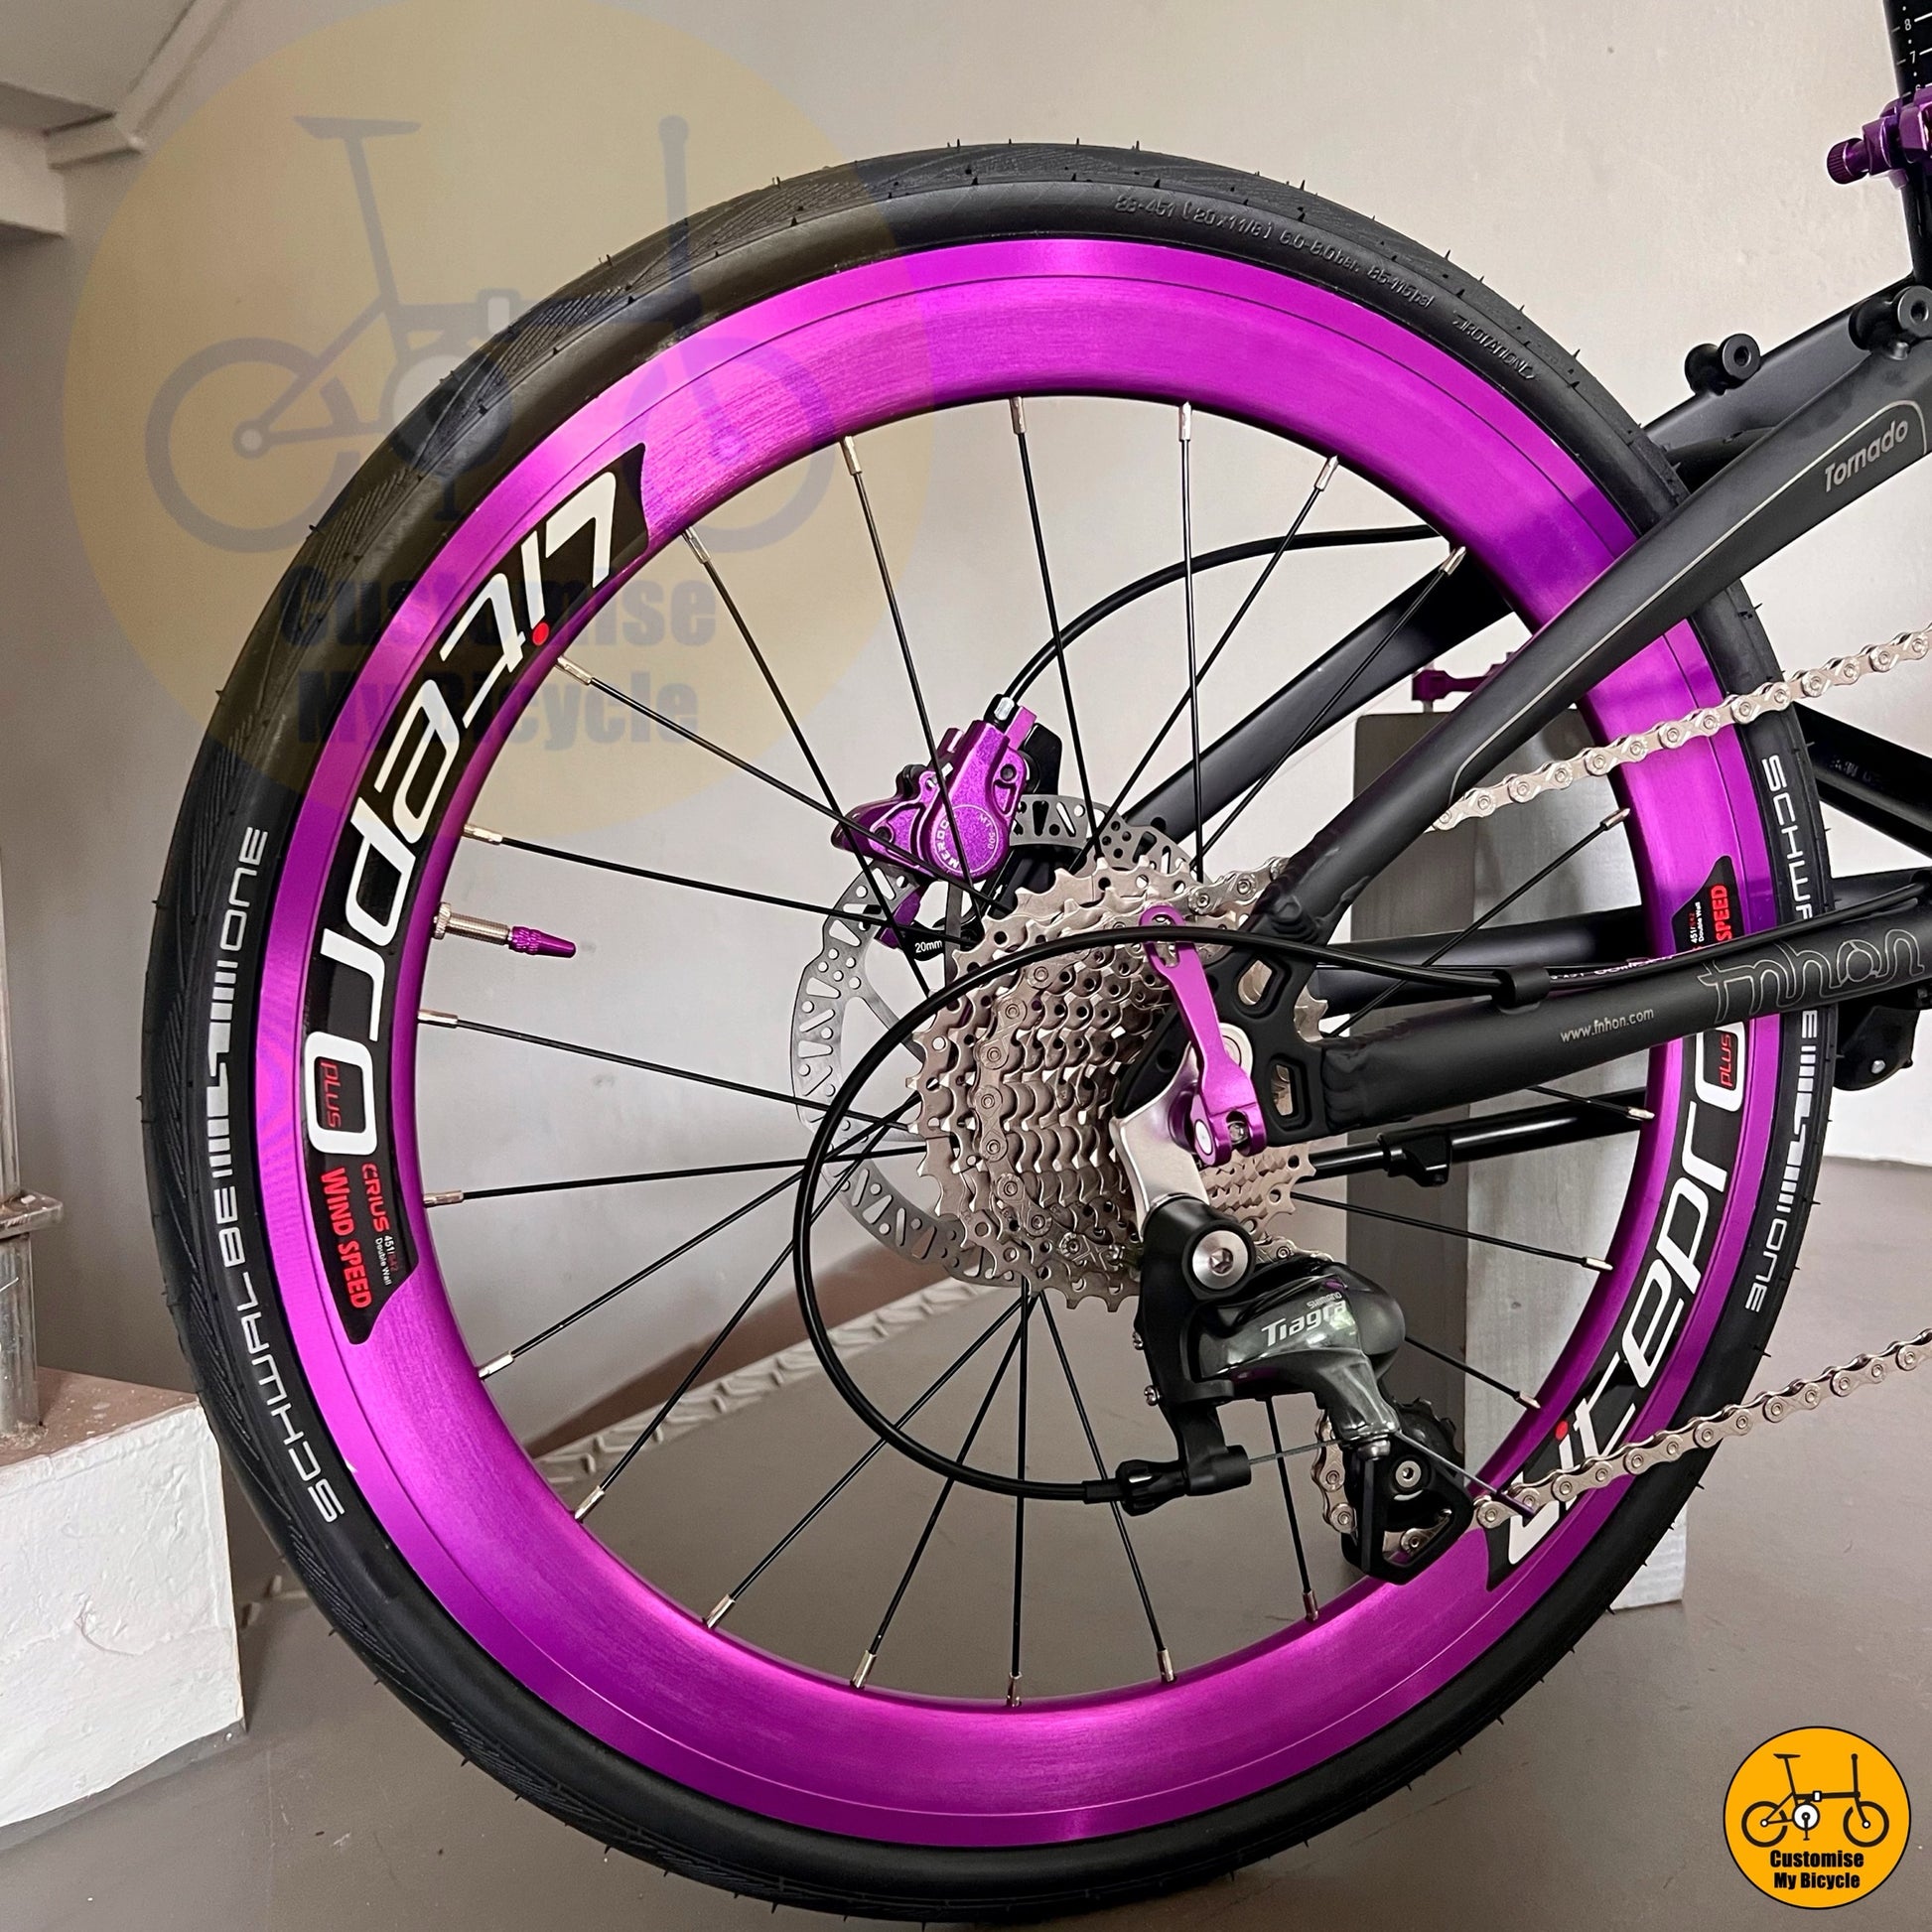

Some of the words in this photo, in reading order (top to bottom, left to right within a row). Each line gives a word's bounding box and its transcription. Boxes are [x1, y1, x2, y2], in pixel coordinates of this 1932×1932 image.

[1904, 19, 1912, 31] 8
[1909, 51, 1916, 64] 7
[1825, 420, 1908, 492] Tornado
[219, 827, 269, 951] ONE
[1711, 885, 1733, 941] SPEED
[914, 939, 943, 953] 20mm
[1560, 1006, 1654, 1042] www.fnhon.com
[361, 1163, 390, 1233] CRIUS
[321, 1167, 354, 1236] WIND
[338, 1240, 372, 1309] SPEED
[375, 1237, 386, 1267] Double
[381, 1266, 392, 1286] Wall
[1745, 1218, 1786, 1312] ONE
[1260, 1300, 1348, 1346] Tiagra
[1307, 1292, 1342, 1309] SHIMANO
[213, 1186, 345, 1522] SCHWALBE
